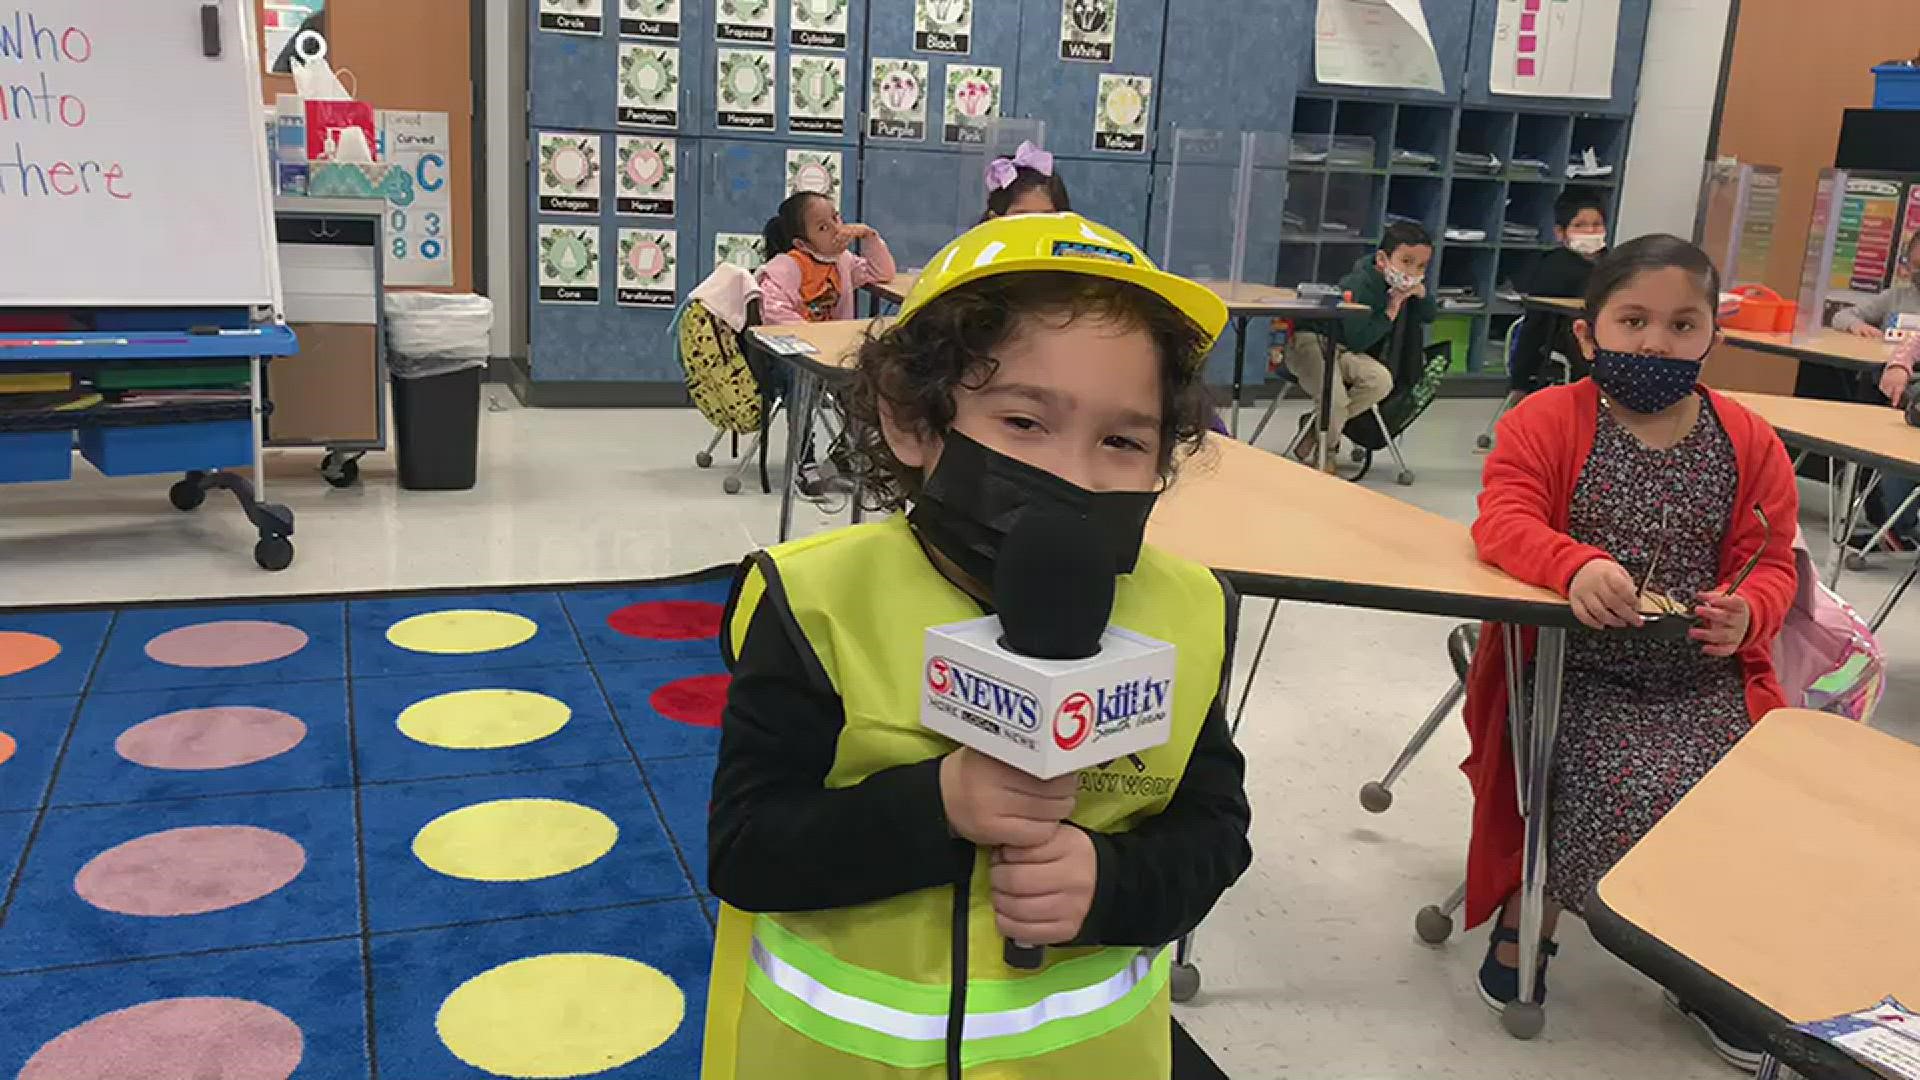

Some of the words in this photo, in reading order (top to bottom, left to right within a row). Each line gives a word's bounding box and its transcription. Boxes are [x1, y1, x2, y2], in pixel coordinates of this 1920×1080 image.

[557, 15, 585, 28] Circle
[640, 21, 660, 33] Oval
[724, 24, 768, 39] Trapezoid
[800, 31, 836, 45] Cylinder
[926, 34, 958, 49] Black
[1069, 42, 1102, 58] White
[626, 109, 671, 124] Pentagon
[878, 120, 915, 139] Purple
[396, 133, 435, 145] Curved
[1104, 133, 1137, 149] Yellow
[416, 154, 444, 193] C
[550, 197, 589, 211] Octagon
[631, 199, 659, 211] Heart
[425, 212, 440, 236] 3
[393, 237, 406, 260] 8
[556, 287, 581, 299] Cone
